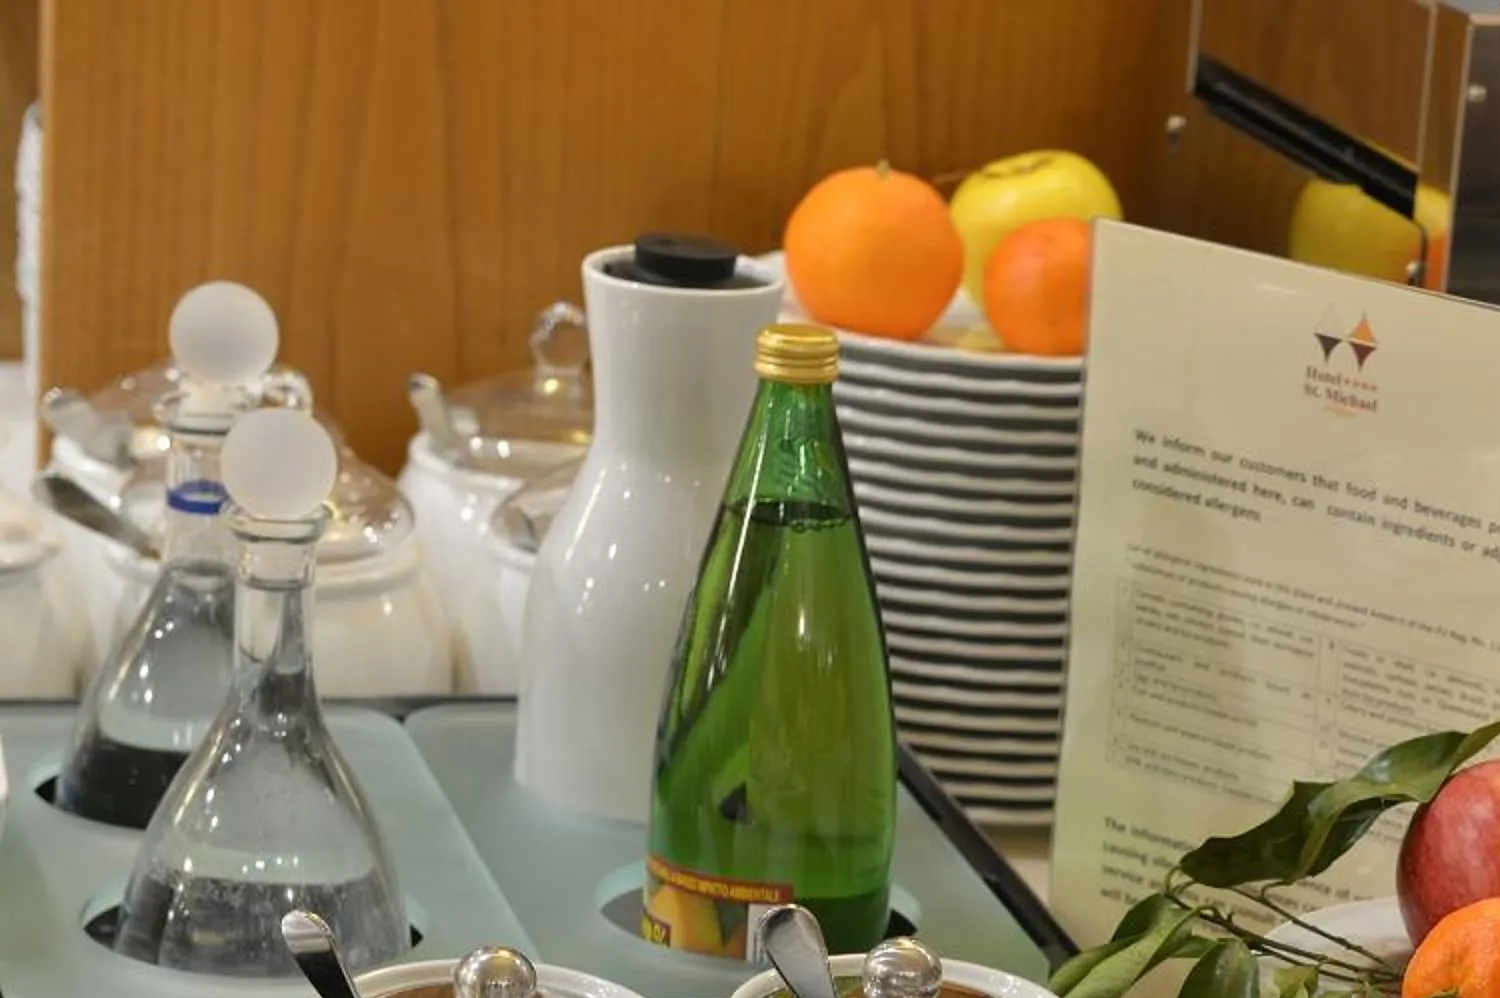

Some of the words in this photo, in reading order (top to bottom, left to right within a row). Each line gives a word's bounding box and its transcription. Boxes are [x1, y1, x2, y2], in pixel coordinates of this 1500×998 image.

[1133, 478, 1201, 506] considered
[1134, 455, 1158, 470] and
[1163, 463, 1248, 493] administered
[1292, 496, 1315, 509] can
[1327, 504, 1375, 527] contain
[1382, 517, 1455, 548] ingredients
[1461, 540, 1476, 552] or
[1135, 428, 1156, 444] We
[1163, 435, 1205, 457] inform
[1210, 450, 1233, 463] our
[1239, 457, 1307, 483] customers
[1312, 473, 1339, 491] that
[1346, 481, 1377, 501] food
[1383, 493, 1408, 510] and
[1414, 500, 1482, 529] beverages
